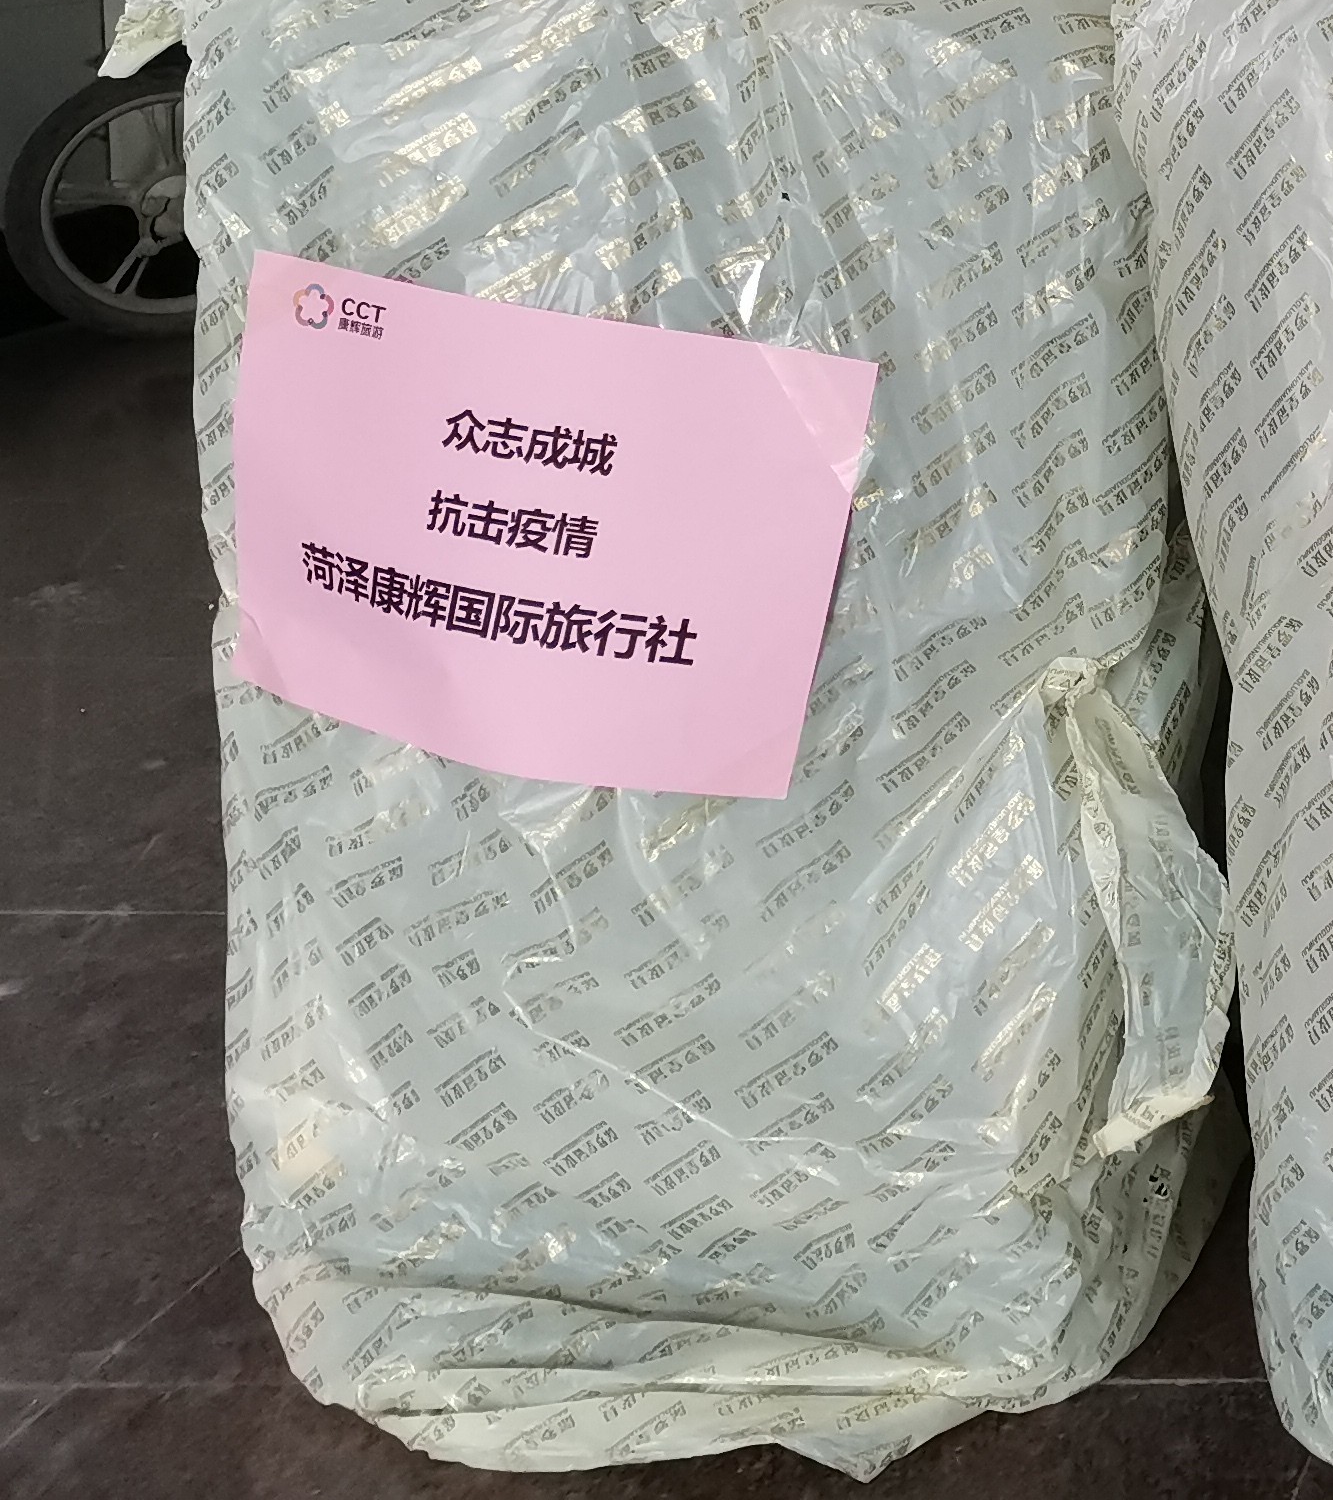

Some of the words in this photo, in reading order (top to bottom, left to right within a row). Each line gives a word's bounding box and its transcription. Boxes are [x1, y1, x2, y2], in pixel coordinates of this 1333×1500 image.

[337, 317, 384, 341] 康辉旅游
[340, 298, 387, 324] CCT
[442, 408, 618, 476] 众志成城
[426, 490, 598, 559] 抗击疫情
[301, 542, 697, 667] 菏泽康辉国际旅行社
